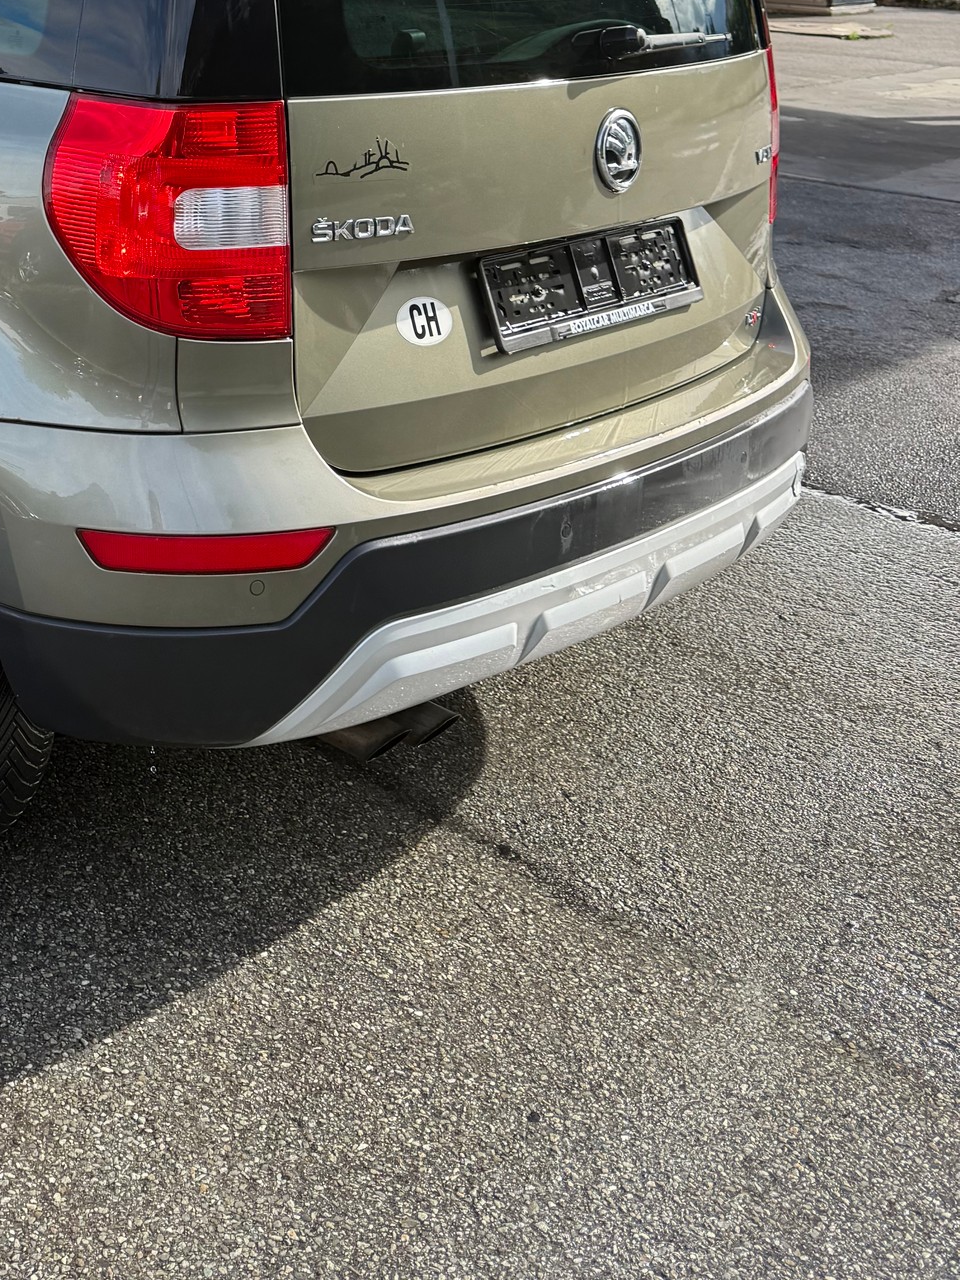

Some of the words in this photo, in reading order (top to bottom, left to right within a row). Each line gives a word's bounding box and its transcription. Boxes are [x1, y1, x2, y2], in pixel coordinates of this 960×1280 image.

[312, 214, 415, 243] ŠKODA
[409, 302, 442, 340] CH
[569, 313, 610, 334] ROYALCAR
[610, 302, 656, 324] MULTIMARCA
